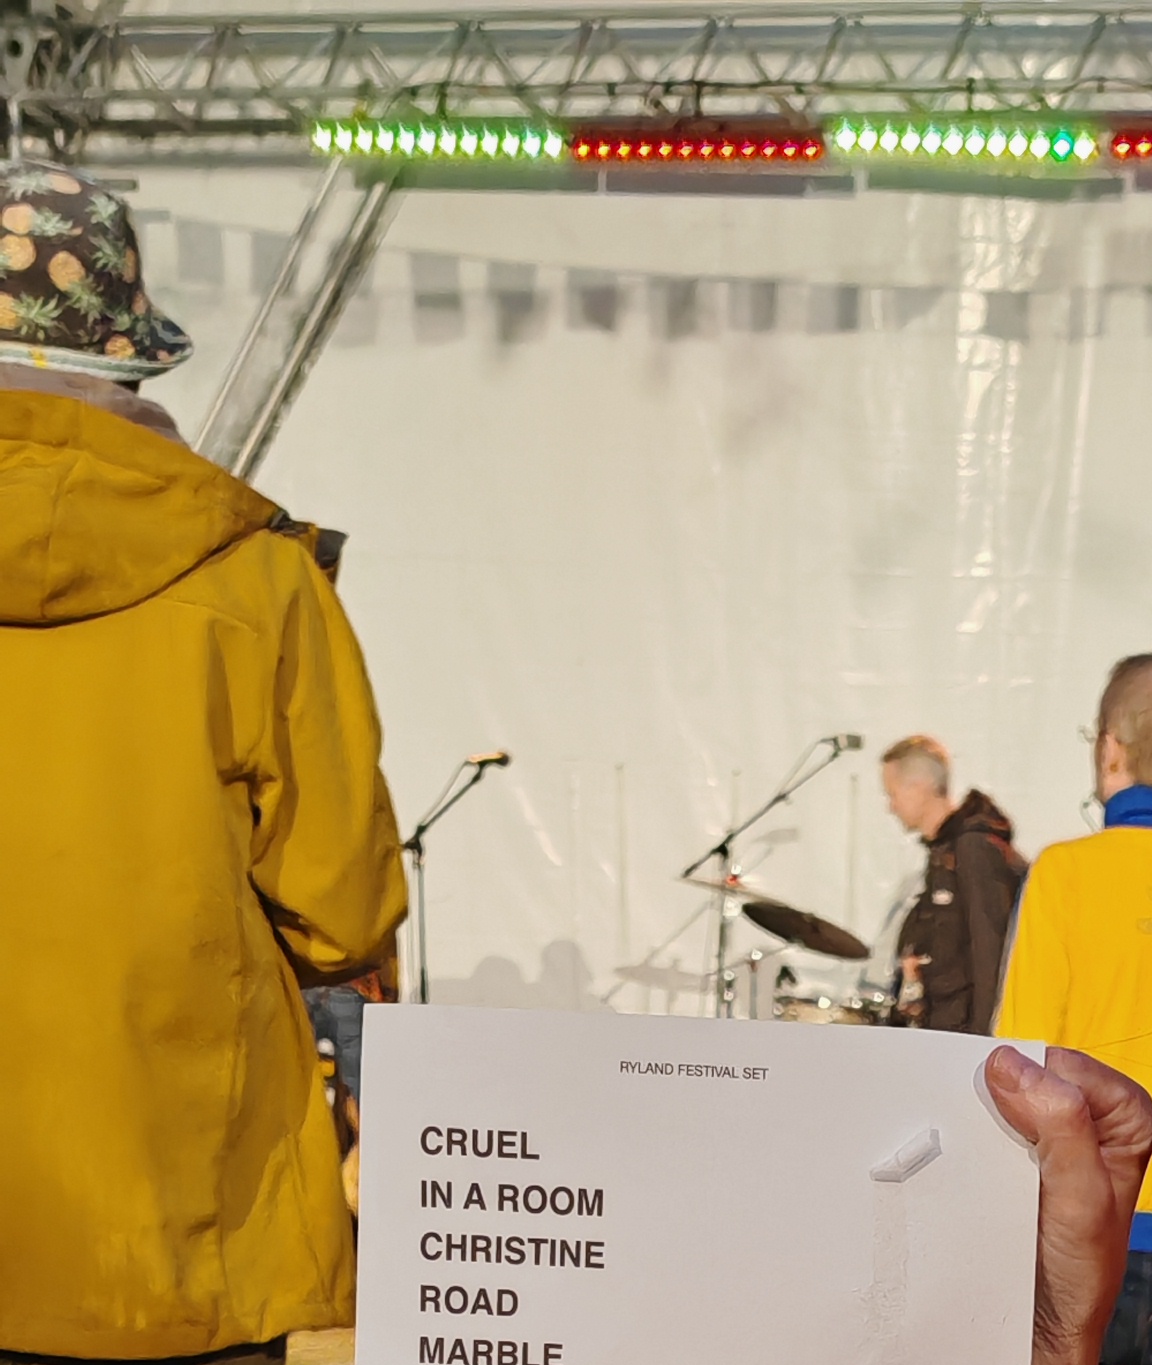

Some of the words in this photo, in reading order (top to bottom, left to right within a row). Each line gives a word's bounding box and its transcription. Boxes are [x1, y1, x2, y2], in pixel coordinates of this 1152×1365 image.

[619, 1060, 674, 1075] RYLAND
[677, 1063, 739, 1079] FESTIVAL
[742, 1066, 769, 1080] SET
[420, 1125, 541, 1161] CRUEL
[420, 1179, 453, 1210] IN
[462, 1182, 487, 1212] A
[497, 1183, 604, 1217] ROOM
[419, 1231, 605, 1270] CHRISTINE
[419, 1284, 519, 1317] ROAD
